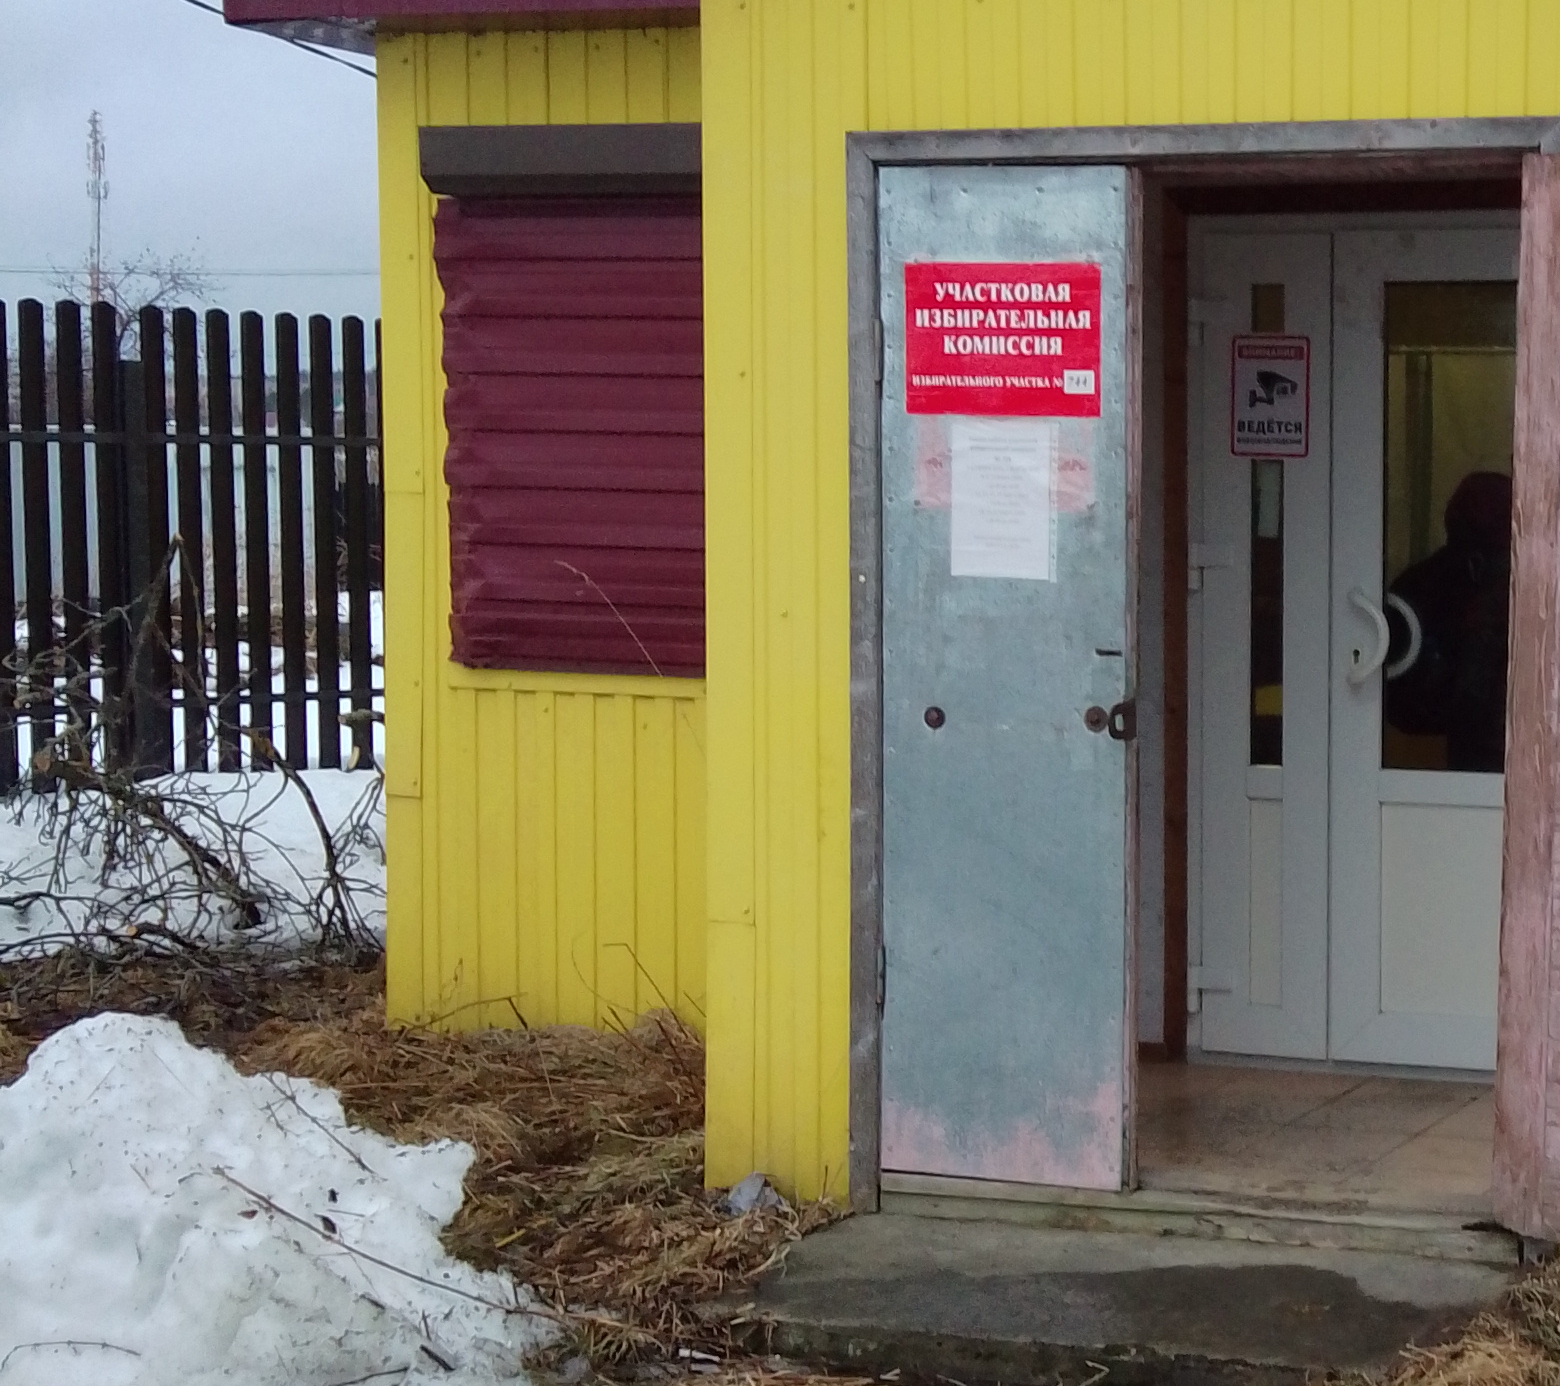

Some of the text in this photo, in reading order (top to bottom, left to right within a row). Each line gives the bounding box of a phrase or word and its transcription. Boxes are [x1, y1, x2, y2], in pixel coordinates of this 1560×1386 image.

[933, 282, 1071, 302] УЧАСТКОВАЯ
[915, 308, 1091, 330] ИЗБИРАТЕЛЬНАЯ
[943, 335, 1063, 356] КОМИССИЯ
[911, 374, 1003, 387] ИЗБИРАТЕЛЬНОГО
[1005, 375, 1051, 388] УЧАСТКА
